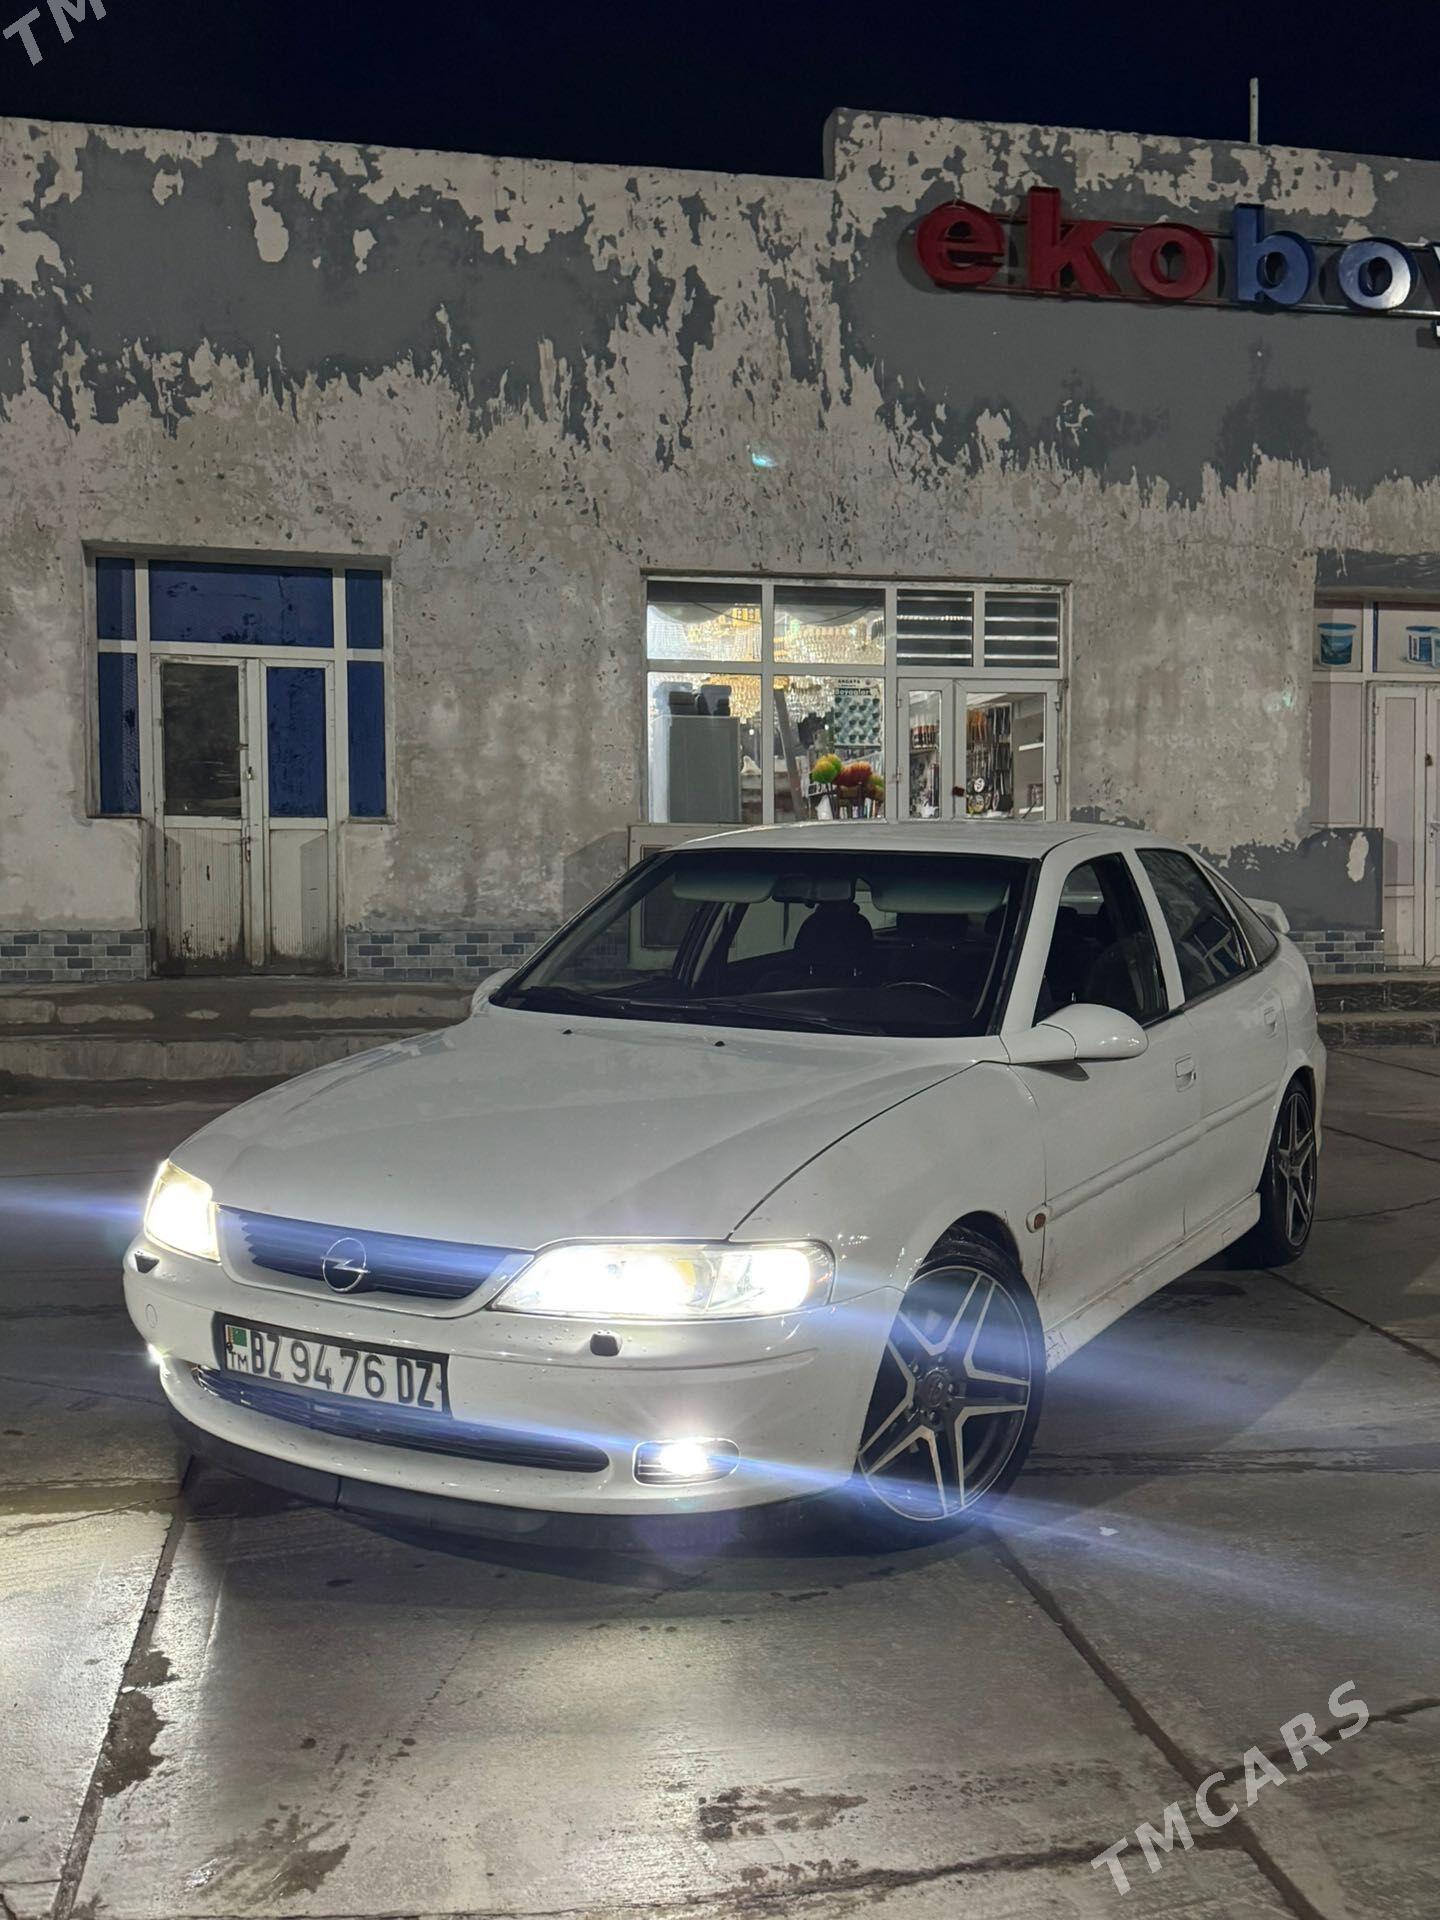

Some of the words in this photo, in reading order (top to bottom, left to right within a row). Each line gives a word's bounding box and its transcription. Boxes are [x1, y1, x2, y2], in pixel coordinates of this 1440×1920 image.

[917, 186, 1440, 338] ekobo
[228, 1351, 249, 1371] TM
[251, 1330, 282, 1379] BZ
[291, 1340, 386, 1398] 9476
[397, 1357, 435, 1407] DZ
